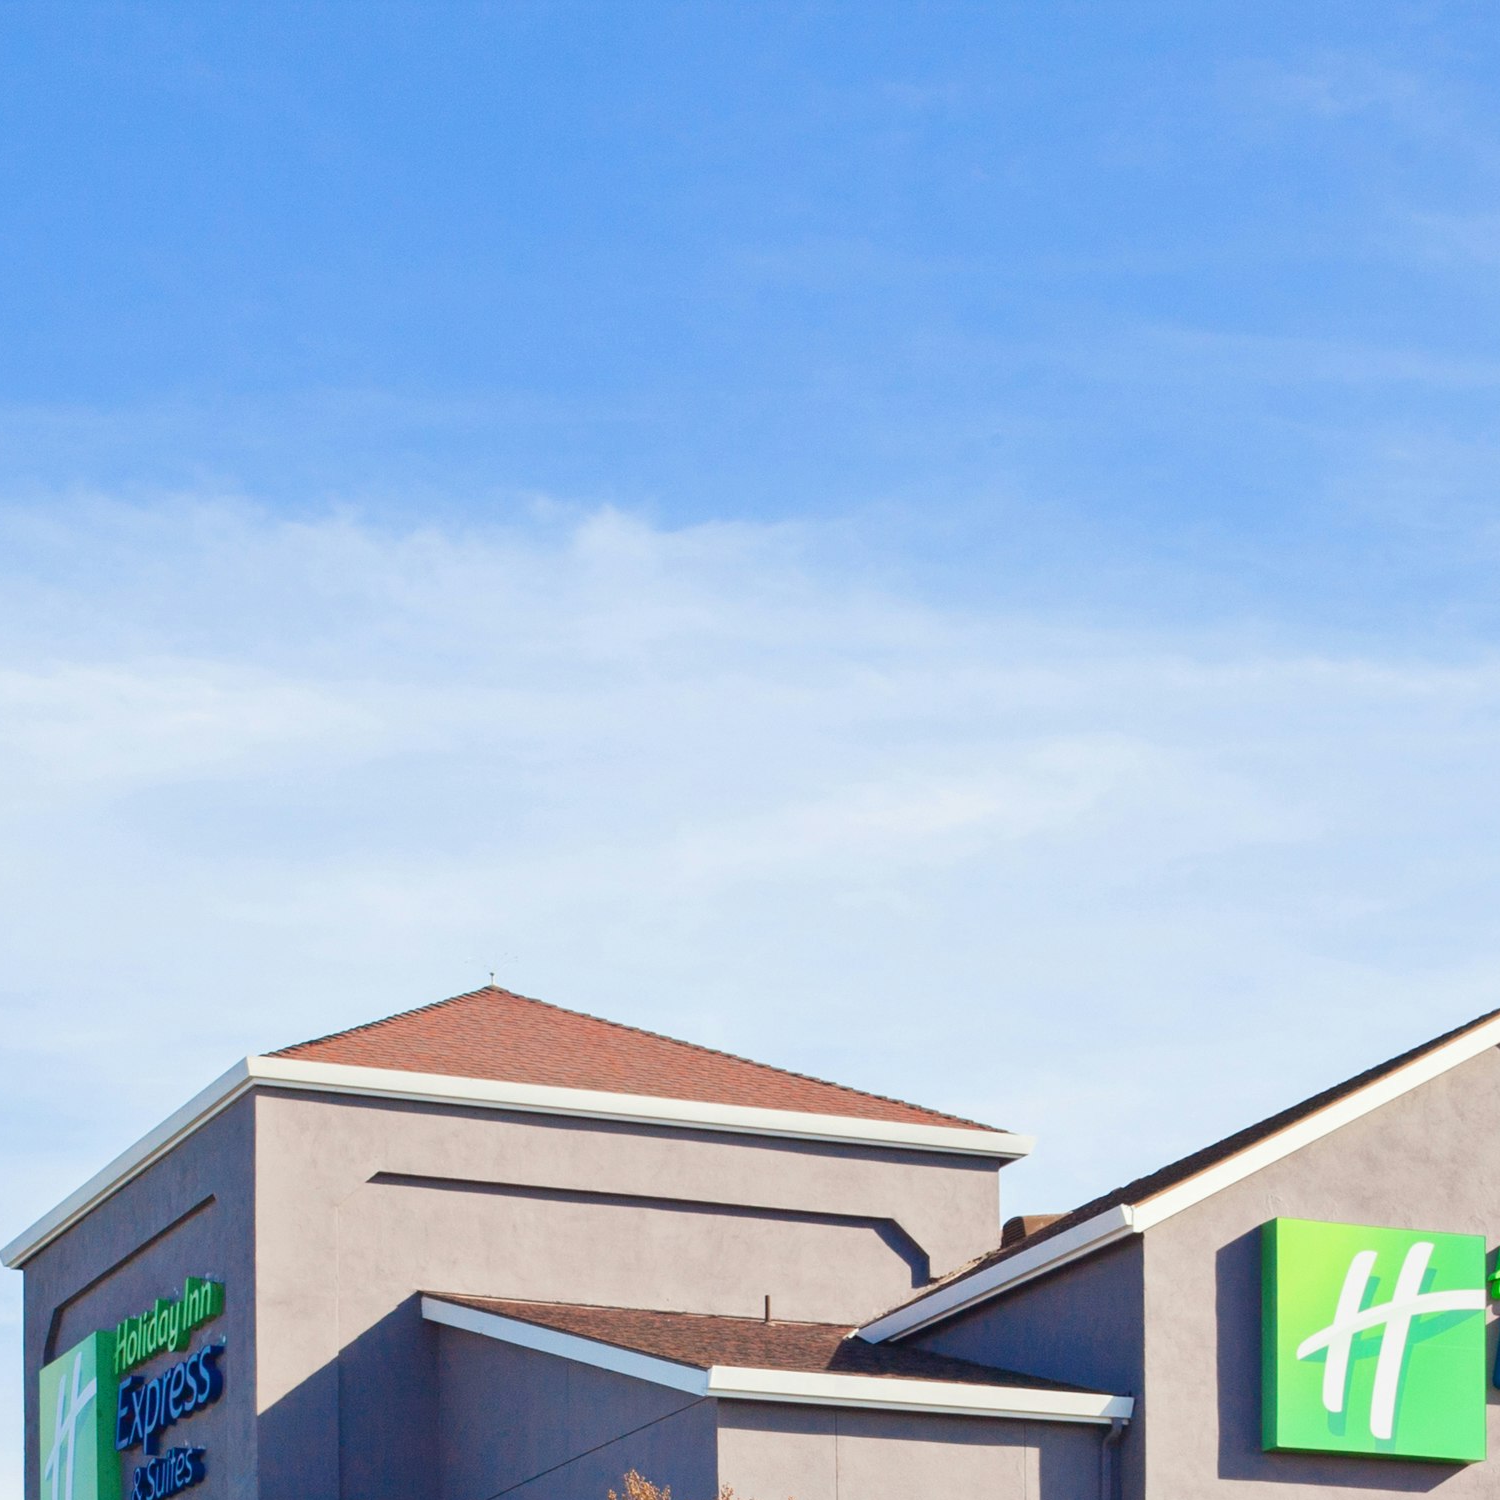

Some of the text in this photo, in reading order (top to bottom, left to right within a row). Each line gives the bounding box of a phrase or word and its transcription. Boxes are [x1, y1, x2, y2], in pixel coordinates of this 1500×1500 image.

[113, 1277, 212, 1374] Holiday Inn
[114, 1344, 214, 1455] Express
